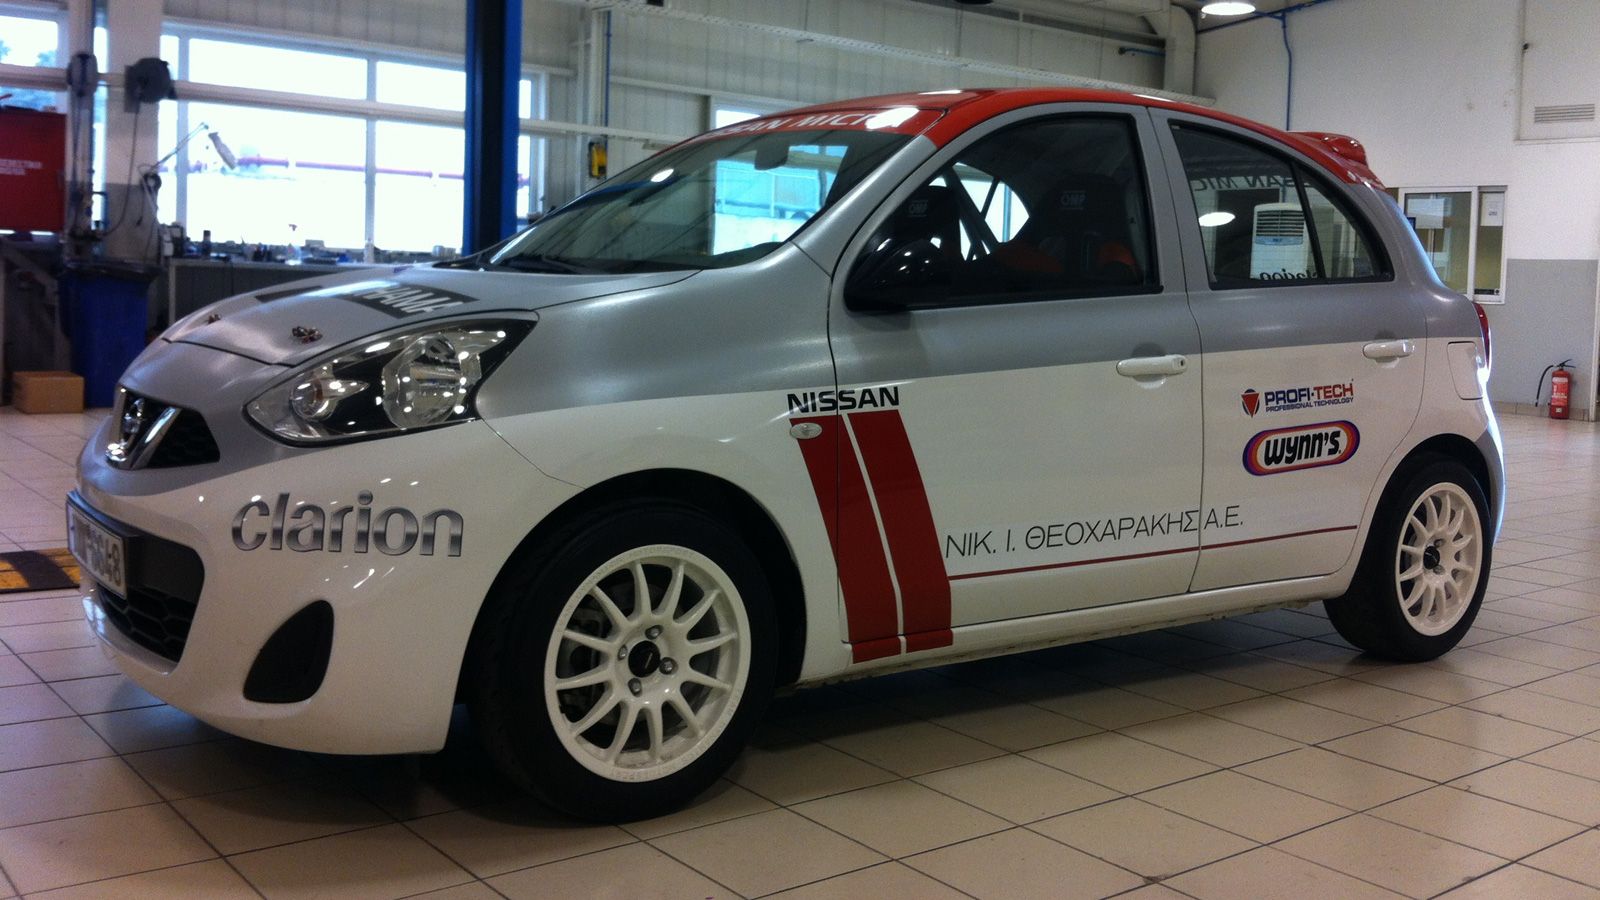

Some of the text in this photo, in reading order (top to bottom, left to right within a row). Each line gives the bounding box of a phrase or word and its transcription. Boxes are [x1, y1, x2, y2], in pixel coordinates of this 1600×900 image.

[787, 386, 899, 413] NISSAN
[1265, 397, 1354, 413] PROFESSIONAL TECHNOLOGY
[231, 489, 464, 557] clarion
[1025, 509, 1199, 550] ΘΕΟΧΑΡΑΚΗΣ
